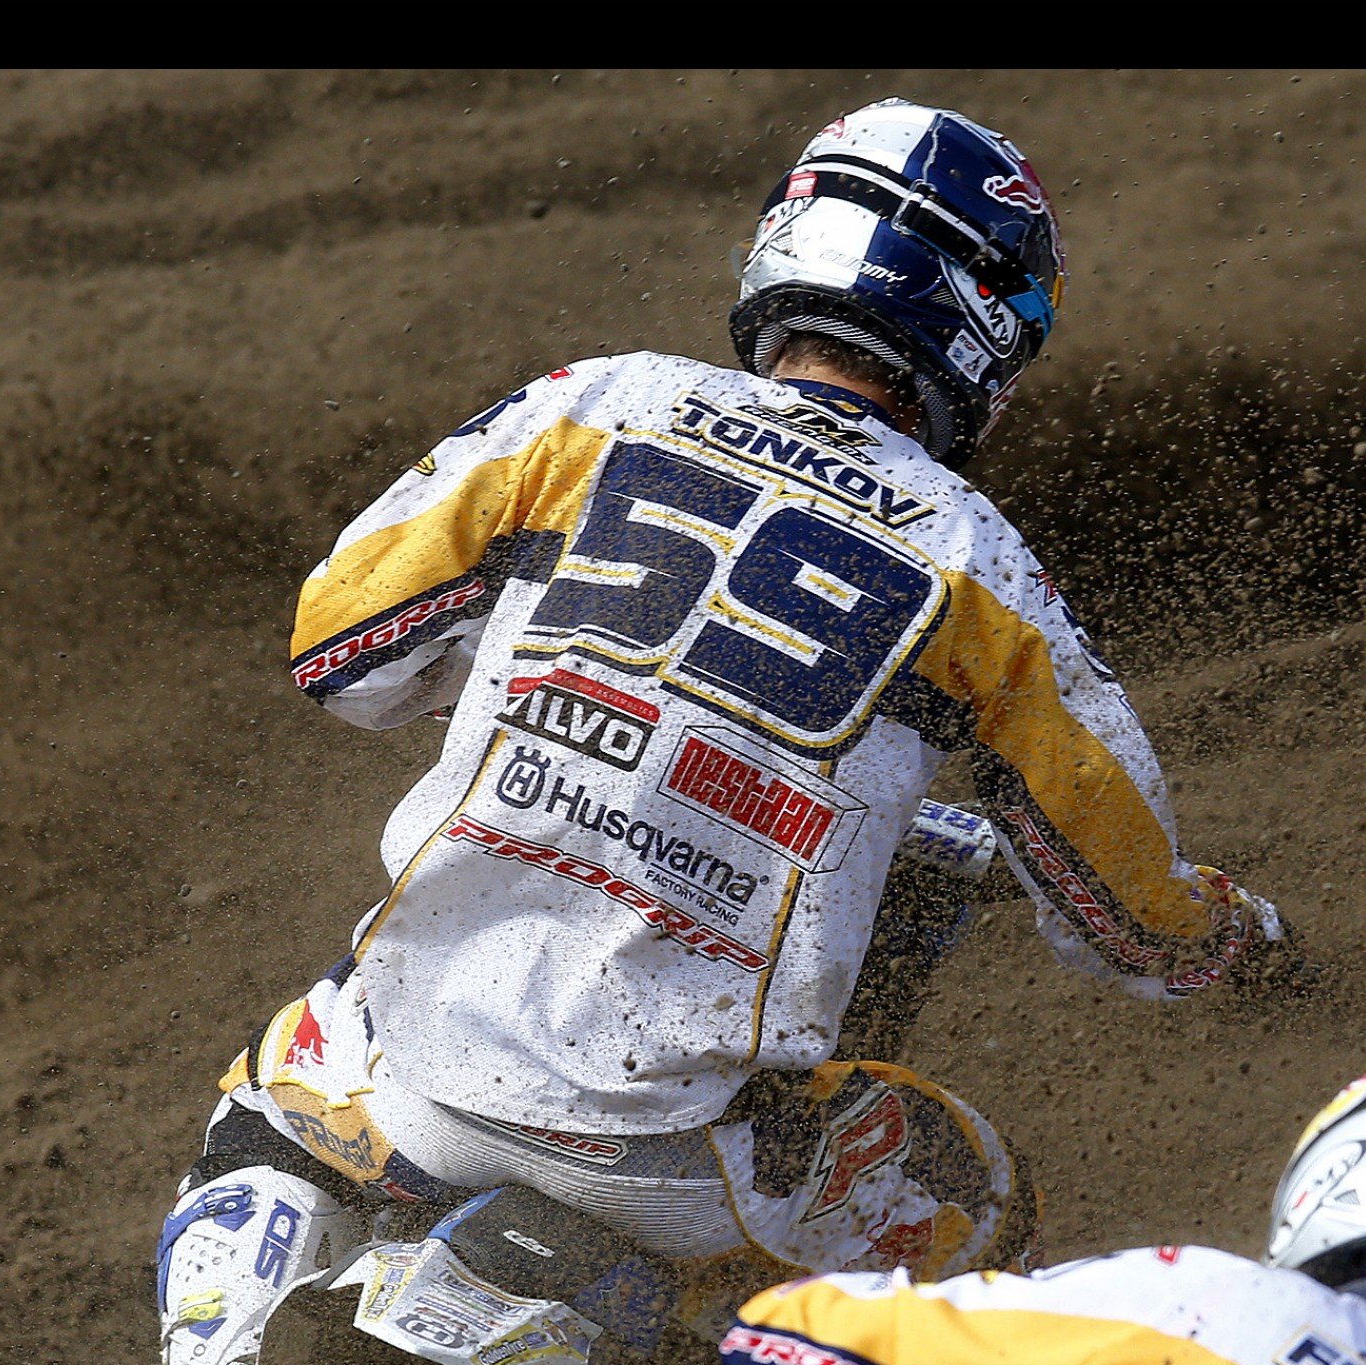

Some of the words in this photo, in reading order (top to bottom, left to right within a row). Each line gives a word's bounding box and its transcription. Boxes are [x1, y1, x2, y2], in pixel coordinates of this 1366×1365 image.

[679, 396, 927, 520] TONKOV
[290, 580, 486, 689] ROGRIP
[521, 436, 947, 745] 59
[446, 815, 771, 972] PROGRIP
[544, 776, 761, 906] Husqvarna
[644, 868, 698, 903] FACTORY
